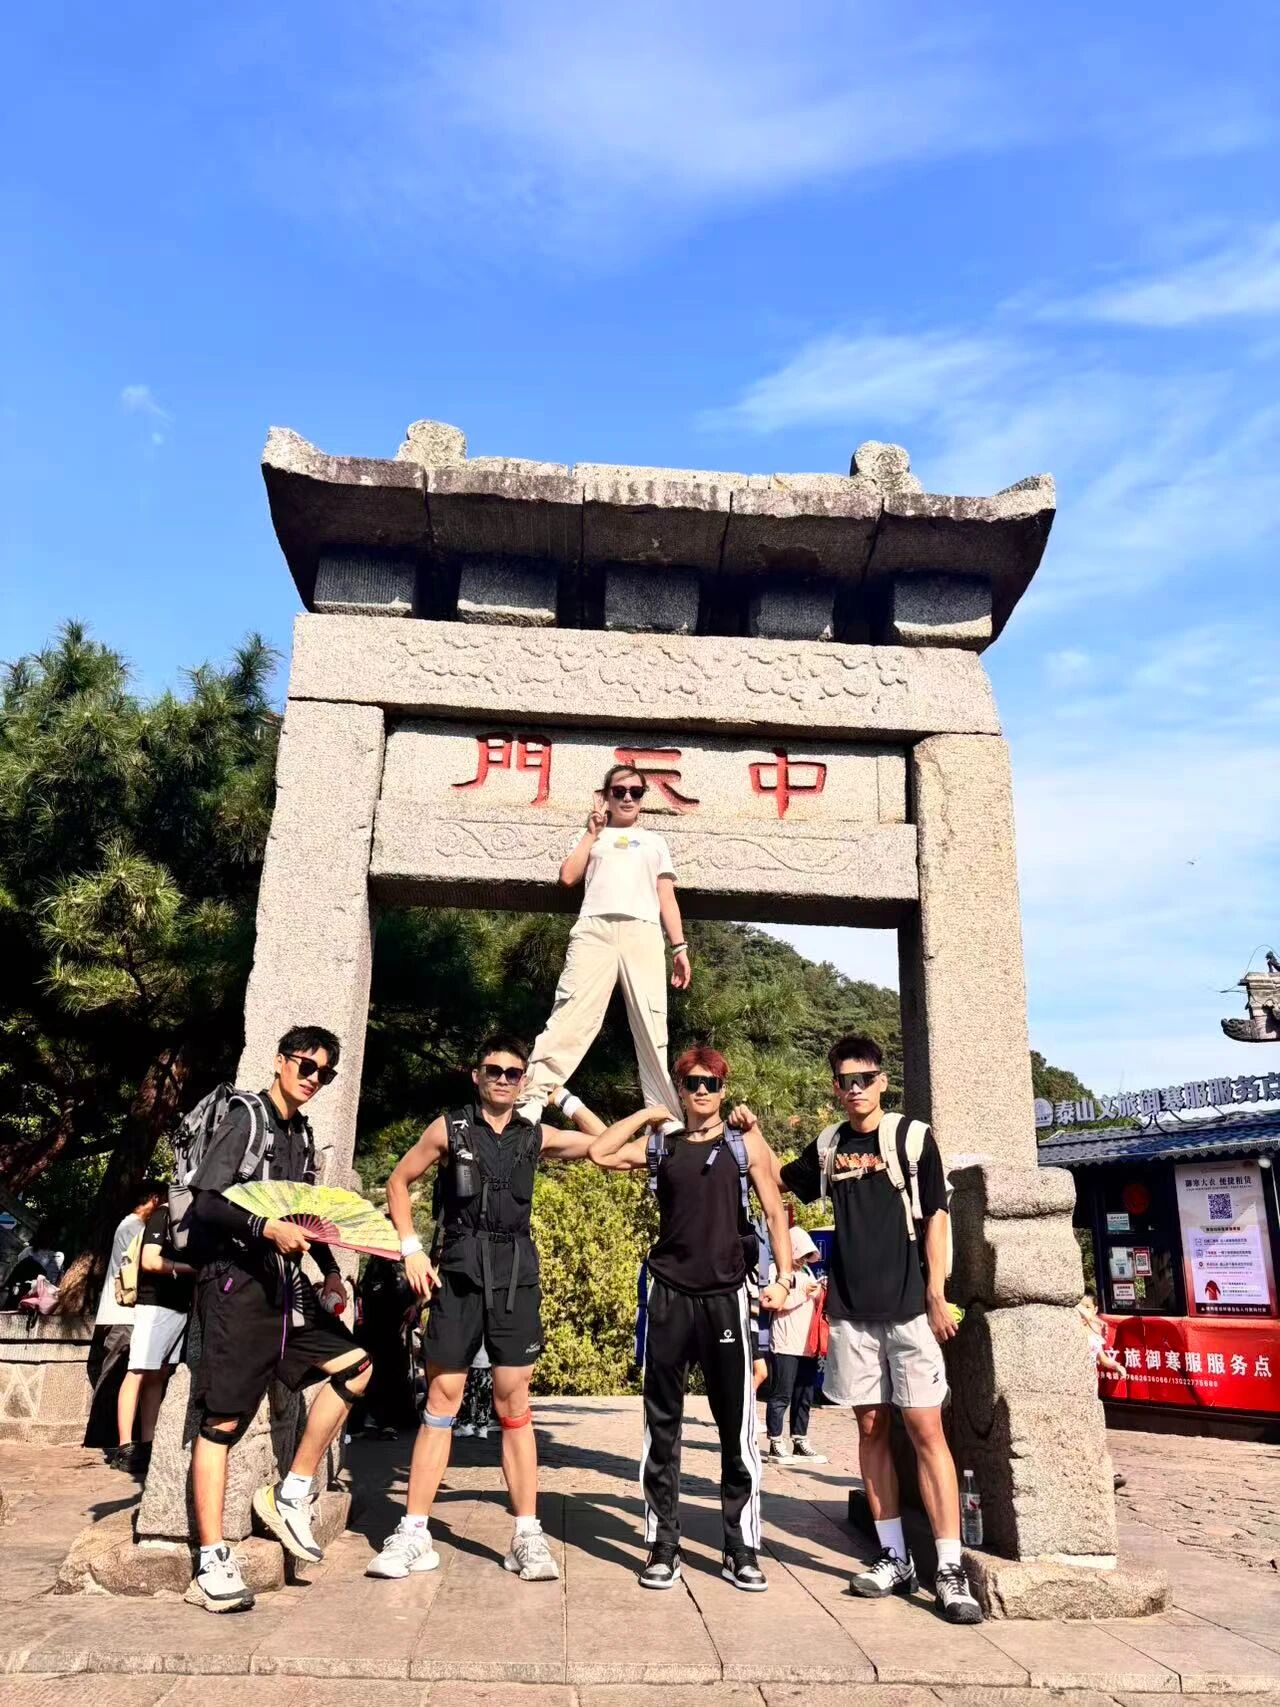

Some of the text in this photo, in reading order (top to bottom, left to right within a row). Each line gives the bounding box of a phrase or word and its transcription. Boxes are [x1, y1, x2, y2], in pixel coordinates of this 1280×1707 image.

[1054, 1072, 1280, 1126] 泰山文旅御寒服服务点
[1095, 1346, 1272, 1378] 文旅御寒服服务点
